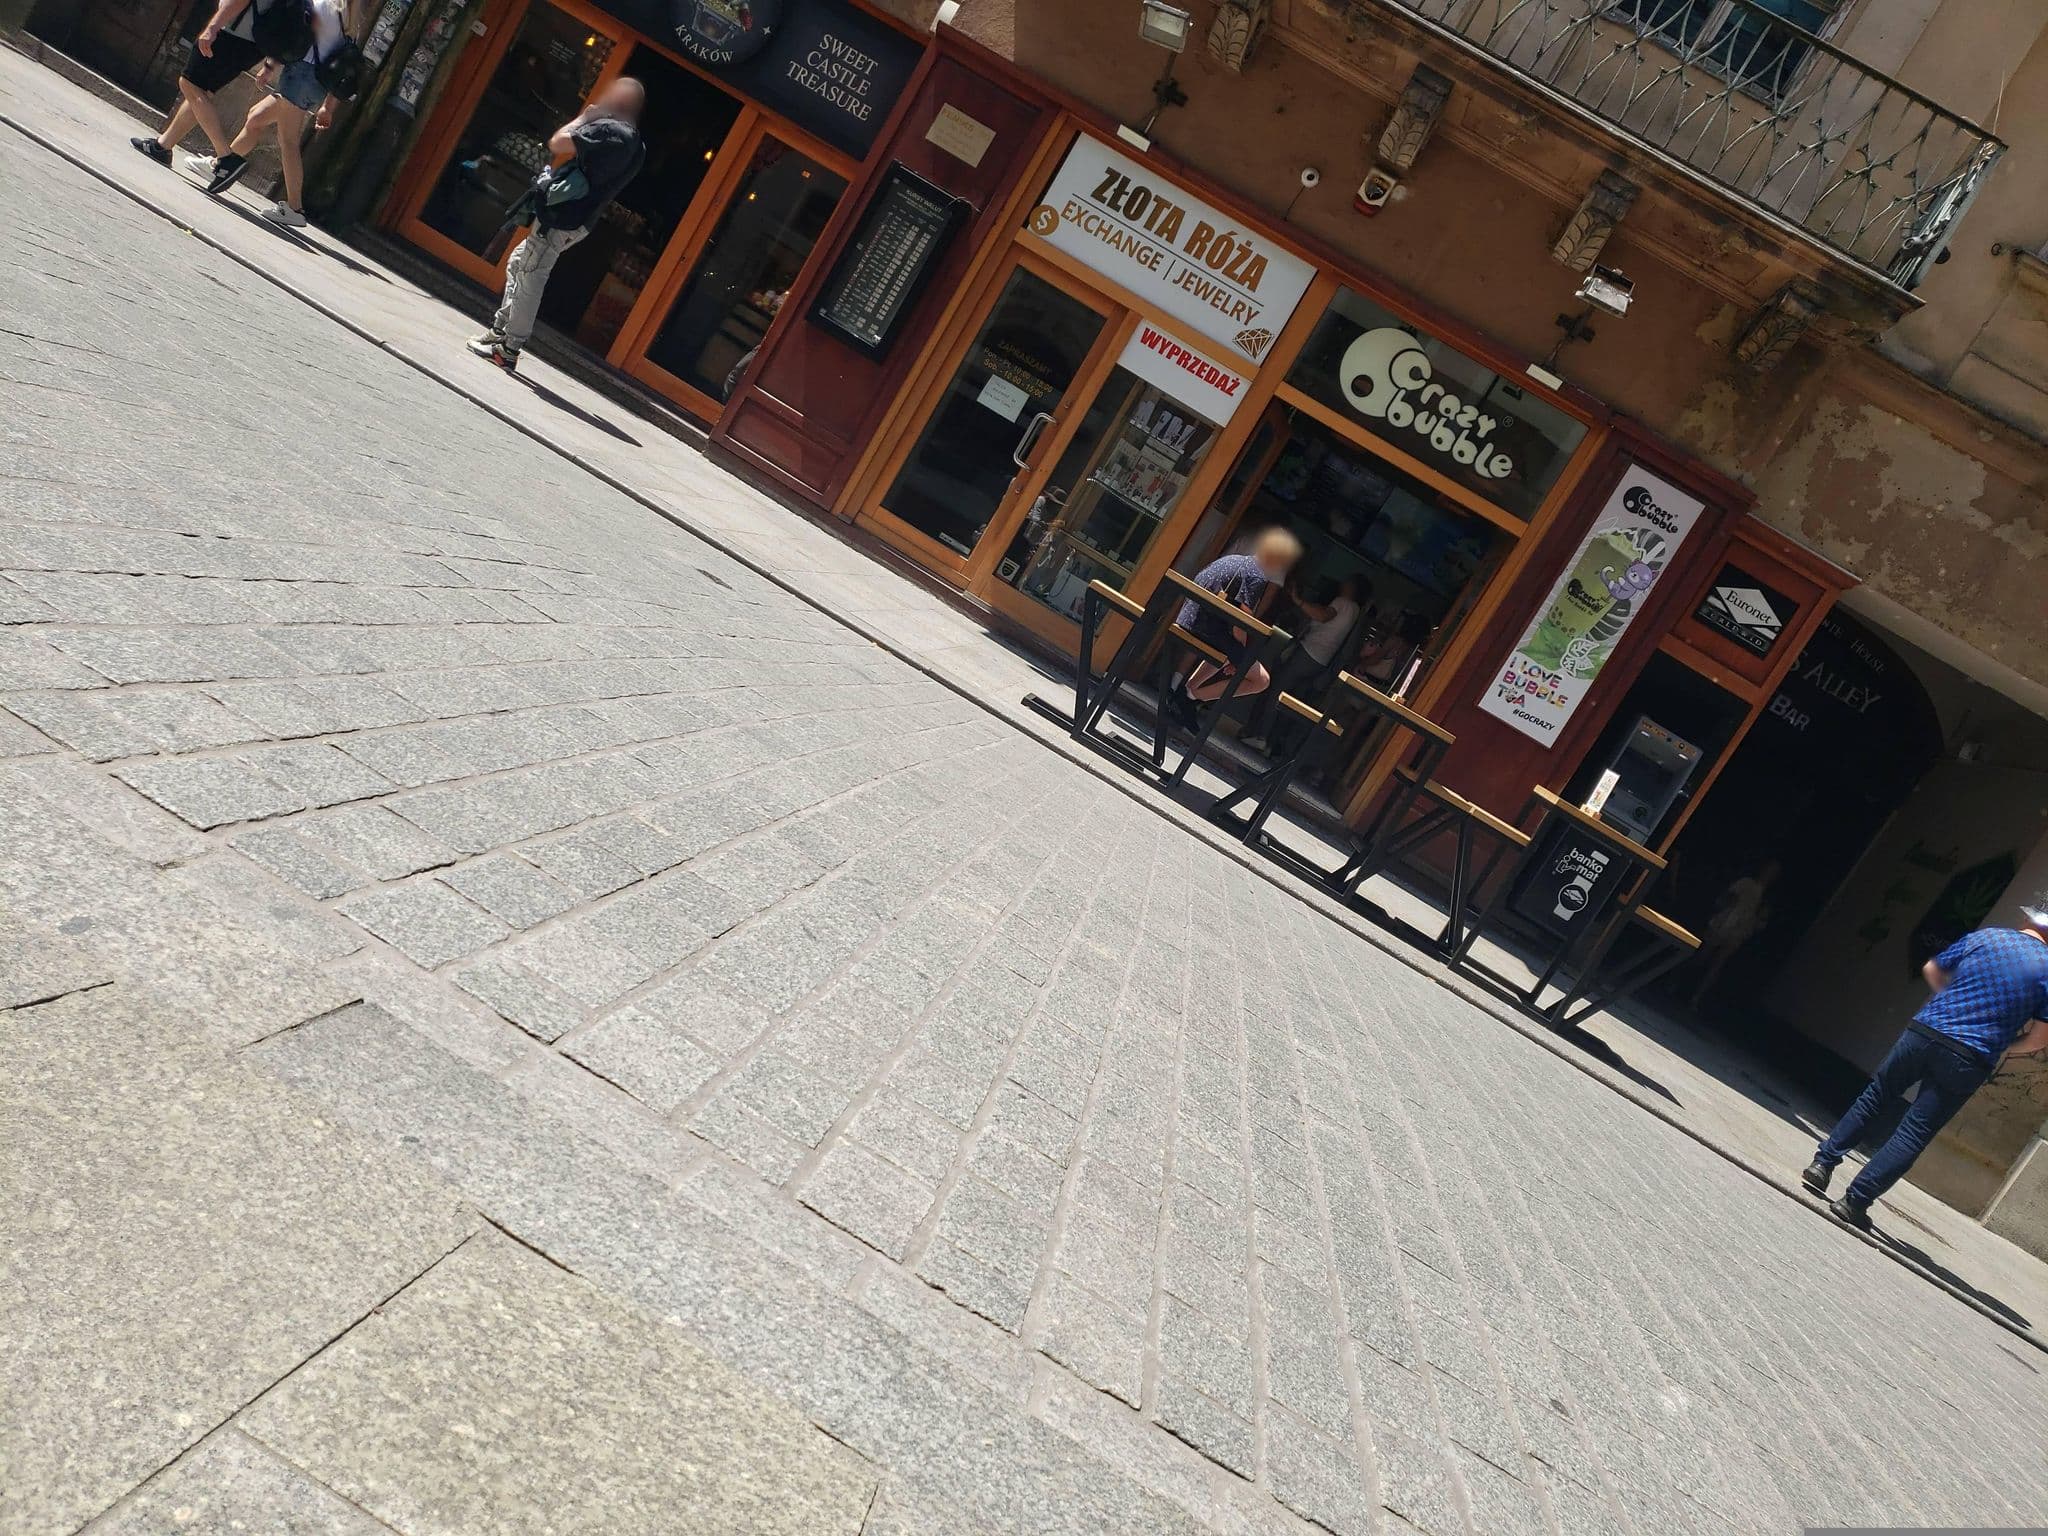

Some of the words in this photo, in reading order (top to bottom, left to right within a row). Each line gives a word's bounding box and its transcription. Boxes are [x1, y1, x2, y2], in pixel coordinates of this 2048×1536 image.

[675, 24, 733, 63] KRAKÓW
[819, 33, 879, 76] SWEET
[786, 60, 873, 121] TREASURE
[806, 50, 872, 97] CASTLE
[1090, 166, 1186, 245] ZŁOTA
[1183, 220, 1269, 293] RÓŻA
[1060, 200, 1164, 273] EXCHANGE
[1172, 268, 1261, 327] JEWELRY
[1139, 327, 1241, 398] WYPRZEDAŻ
[1390, 351, 1497, 439] Crazy
[1386, 388, 1513, 479] bubble
[1637, 507, 1679, 534] bubble
[1639, 492, 1674, 521] Crazy
[1724, 589, 1774, 624] Euronet
[1503, 670, 1569, 710] BUBBLE
[1509, 656, 1518, 668] I
[1519, 660, 1563, 689] LOVE
[1803, 661, 1882, 713] ALLEY
[1512, 708, 1556, 731] #GOCRAZY
[1768, 694, 1810, 731] BAR
[1570, 847, 1604, 875] banko
[1575, 863, 1600, 882] mat
